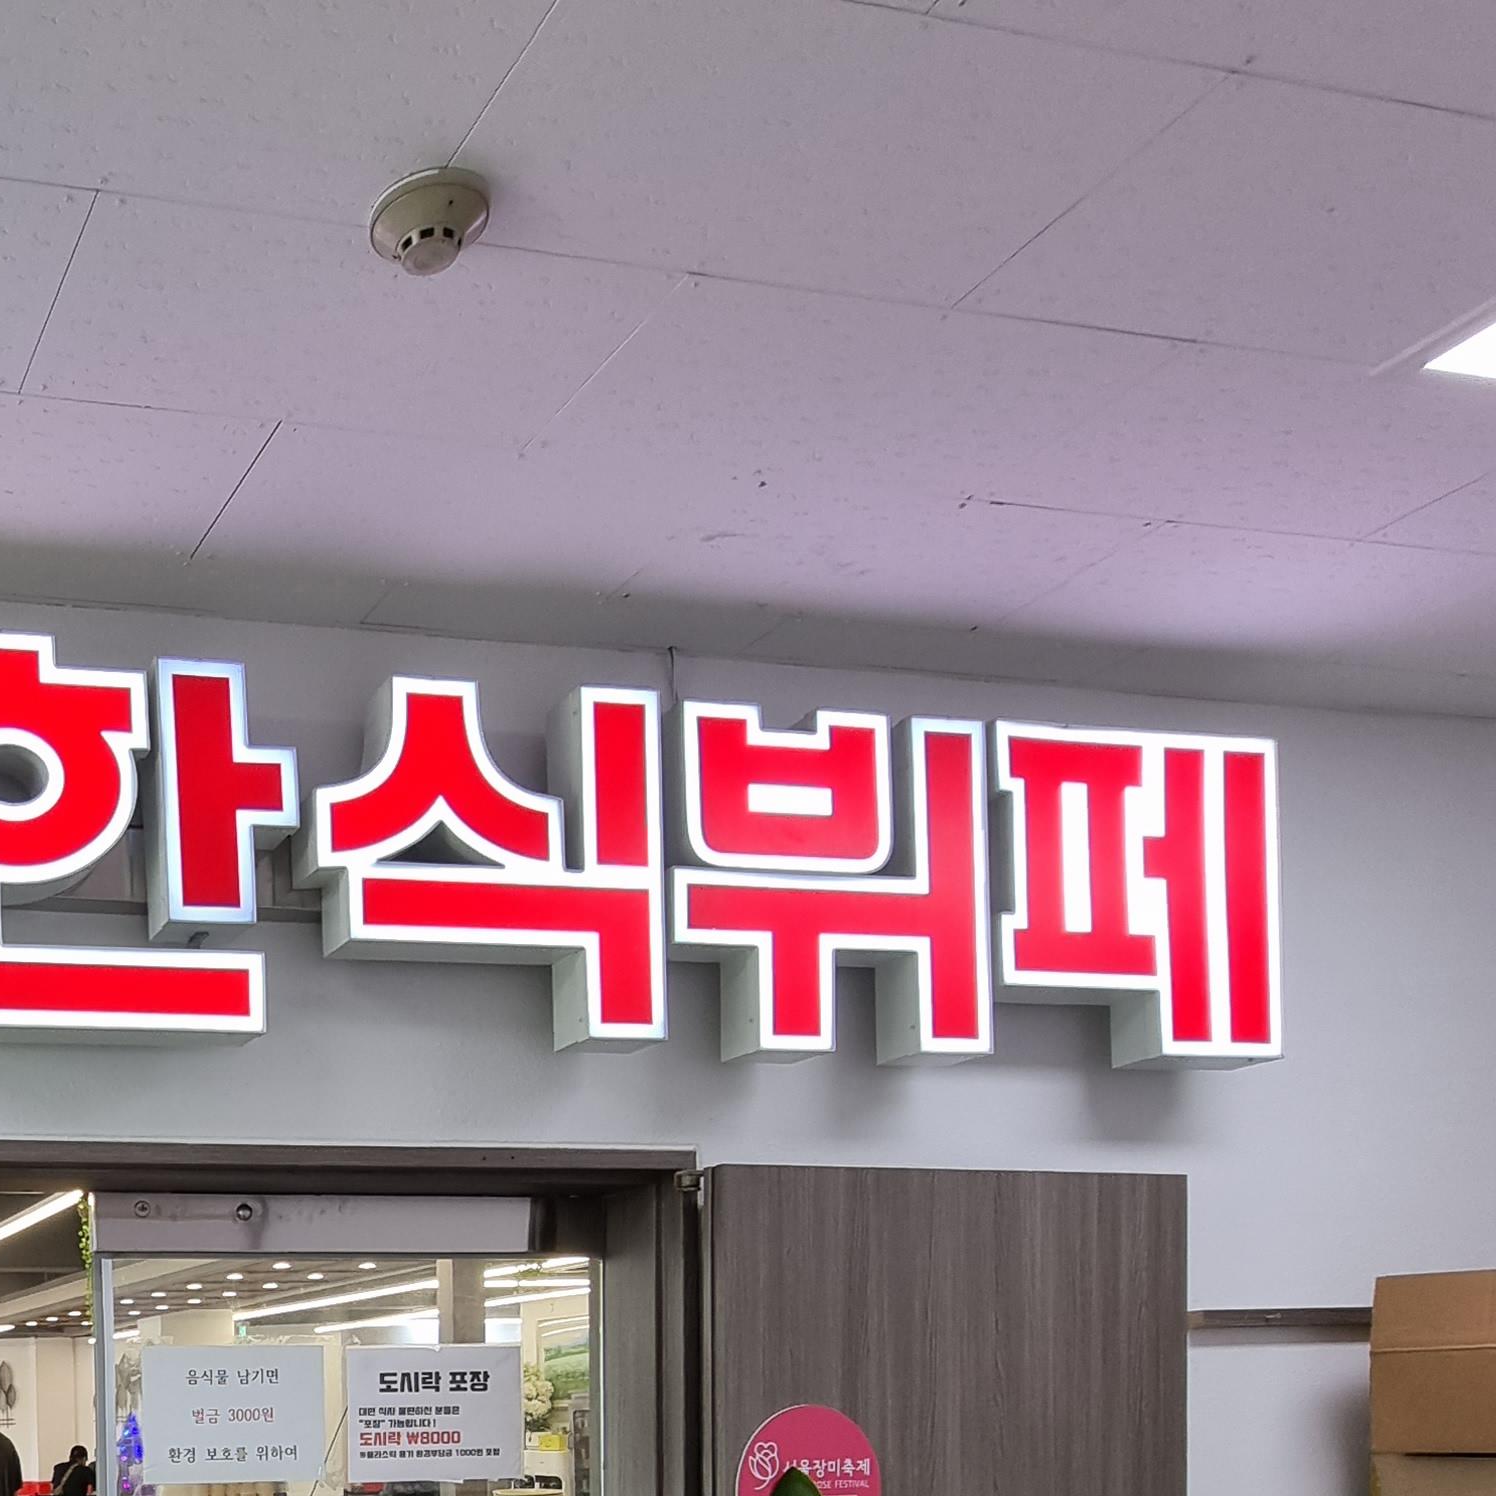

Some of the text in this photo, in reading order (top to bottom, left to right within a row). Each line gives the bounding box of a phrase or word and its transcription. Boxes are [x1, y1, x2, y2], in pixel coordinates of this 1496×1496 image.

[185, 1367, 279, 1385] 음식물 남기면
[378, 1370, 490, 1393] 도시락 포장
[192, 1407, 275, 1424] 벌금 3000원
[359, 1431, 401, 1446] 도시락
[168, 1445, 297, 1463] 환경 보호를 위하여
